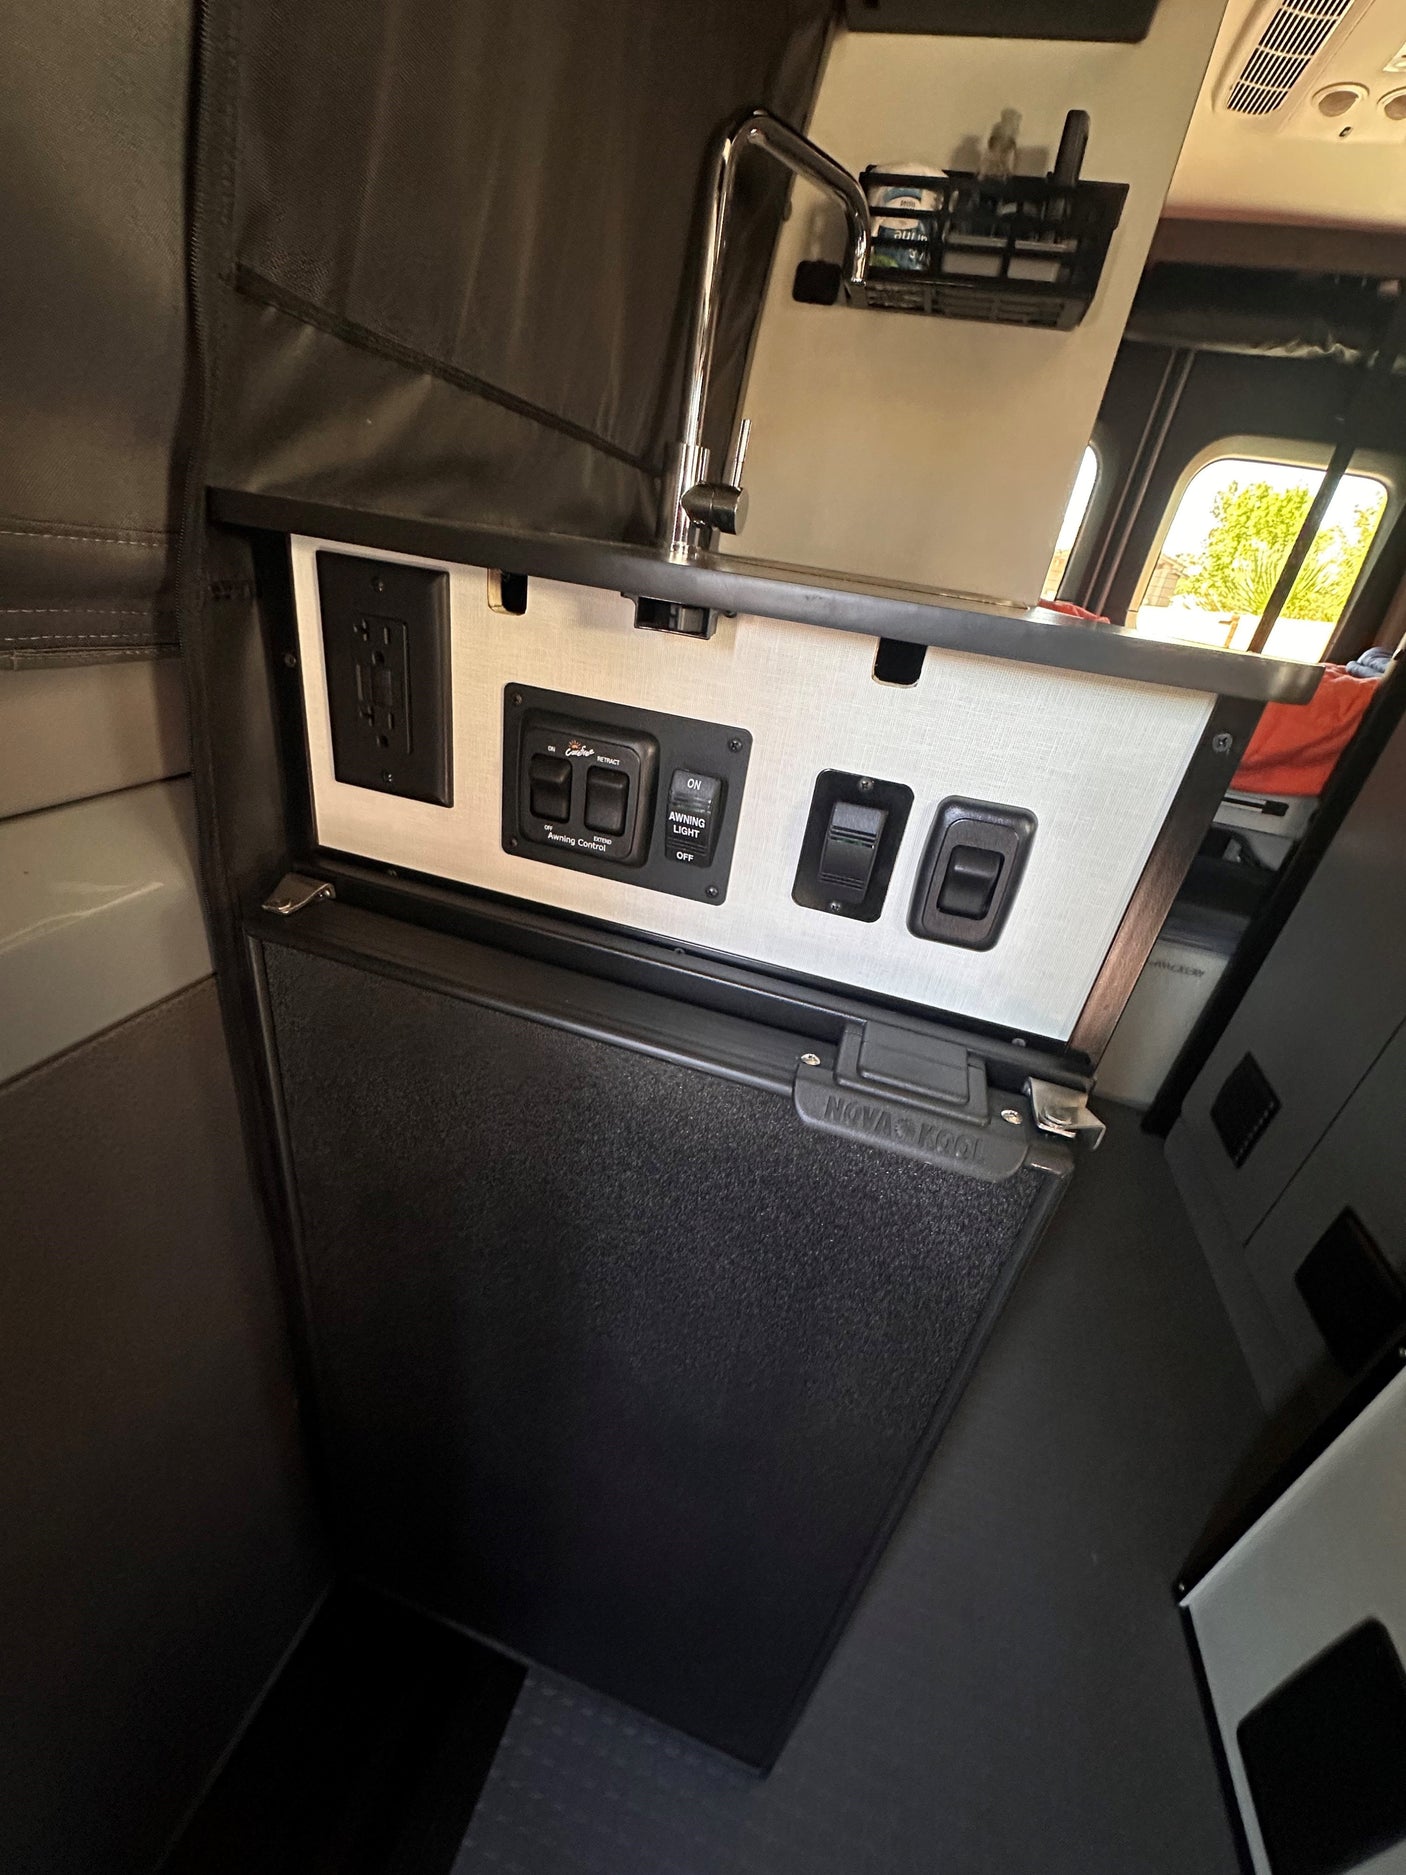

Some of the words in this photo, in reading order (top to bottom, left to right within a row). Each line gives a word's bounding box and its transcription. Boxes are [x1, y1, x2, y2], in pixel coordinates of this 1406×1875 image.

[597, 755, 620, 766] RETRACT
[687, 778, 702, 790] ON
[668, 811, 706, 829] AWNING
[673, 824, 700, 838] LIGHT
[547, 831, 576, 846] Awning
[577, 838, 606, 852] Control
[593, 835, 612, 845] EXTEND
[676, 851, 694, 862] OFF
[824, 1095, 892, 1138] NOVA
